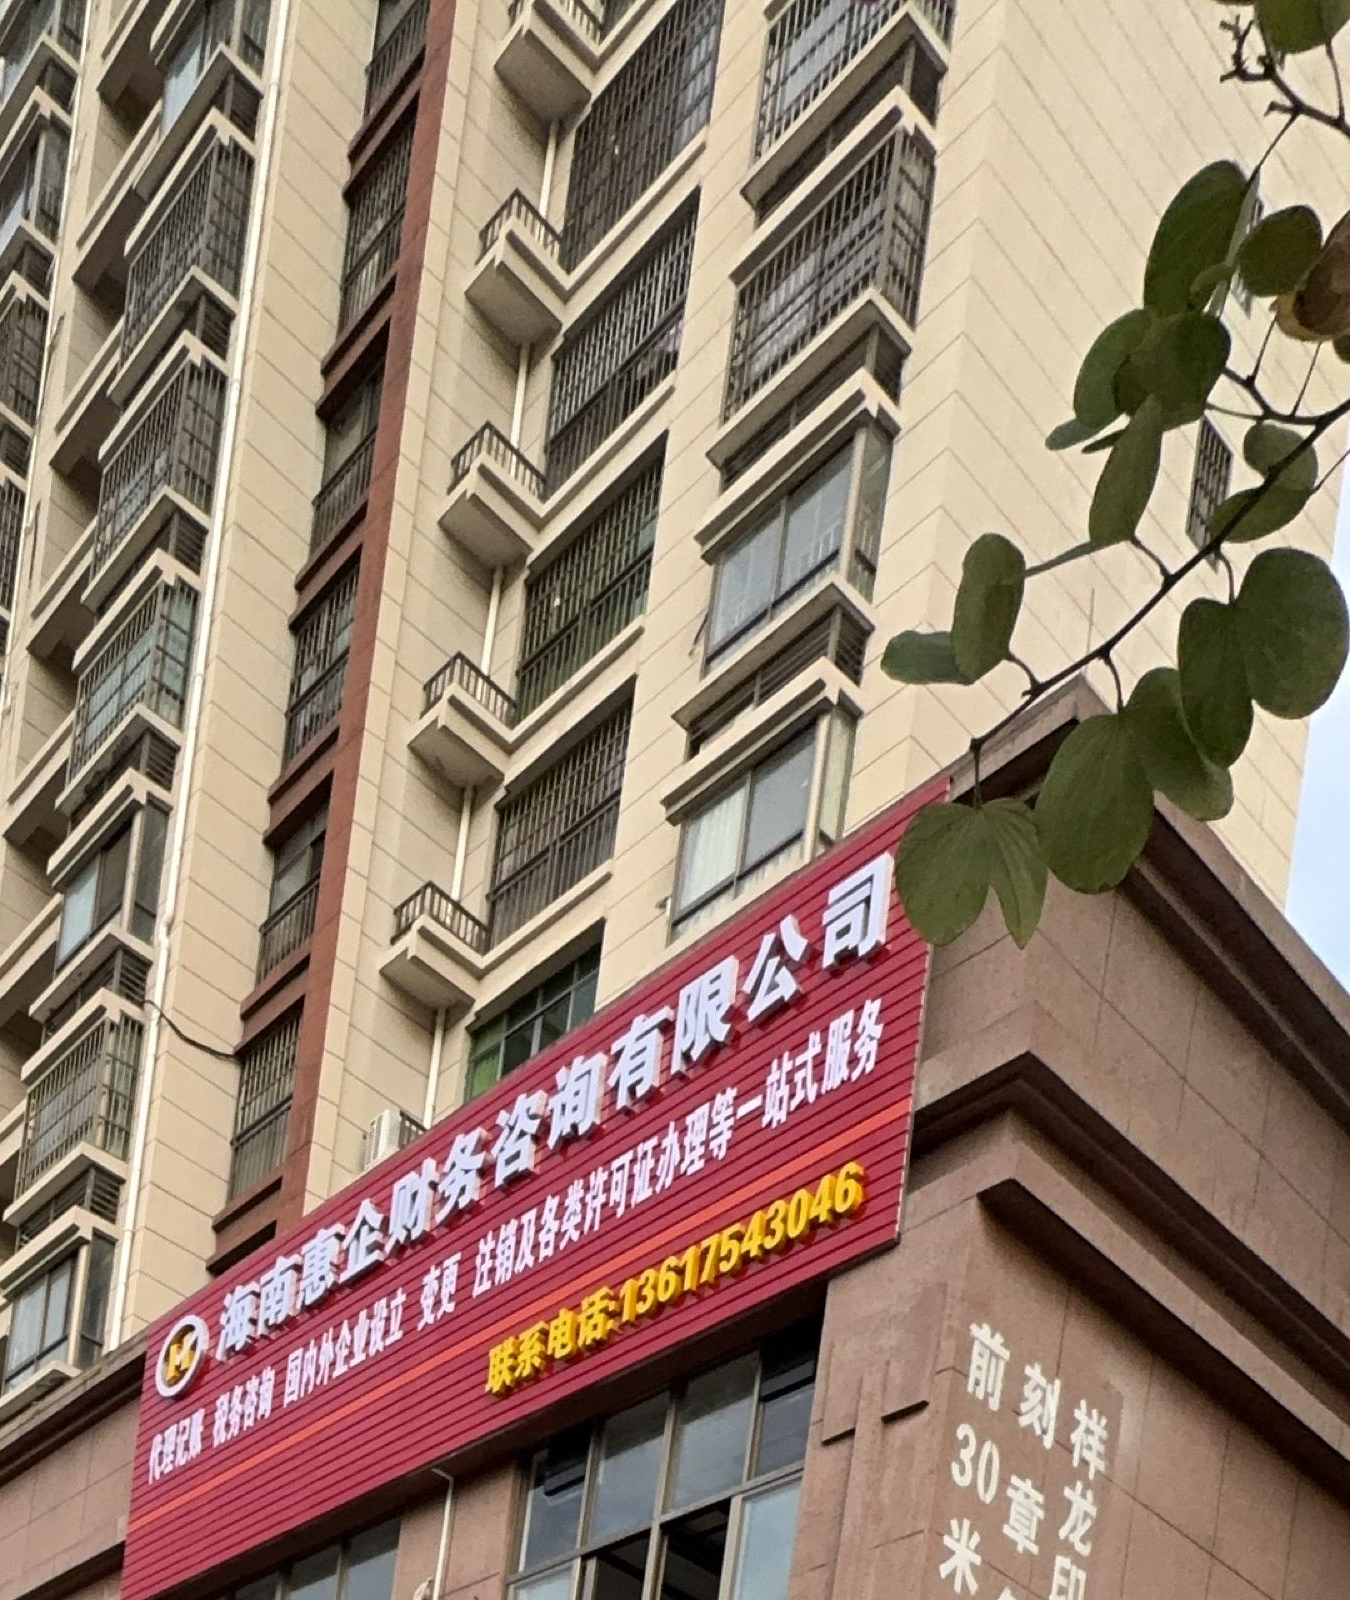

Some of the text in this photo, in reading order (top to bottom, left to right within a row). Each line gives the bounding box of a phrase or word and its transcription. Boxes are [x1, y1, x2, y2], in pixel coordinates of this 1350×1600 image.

[148, 998, 885, 1485] 代理记账 税务咨询 国内外企业设立 变更 注销及各类许可证办理等一站式服务
[215, 853, 896, 1362] 海南惠企财务咨询有限公司
[485, 1161, 867, 1396] 联系电话:13617543046
[938, 1322, 1011, 1597] 前30米
